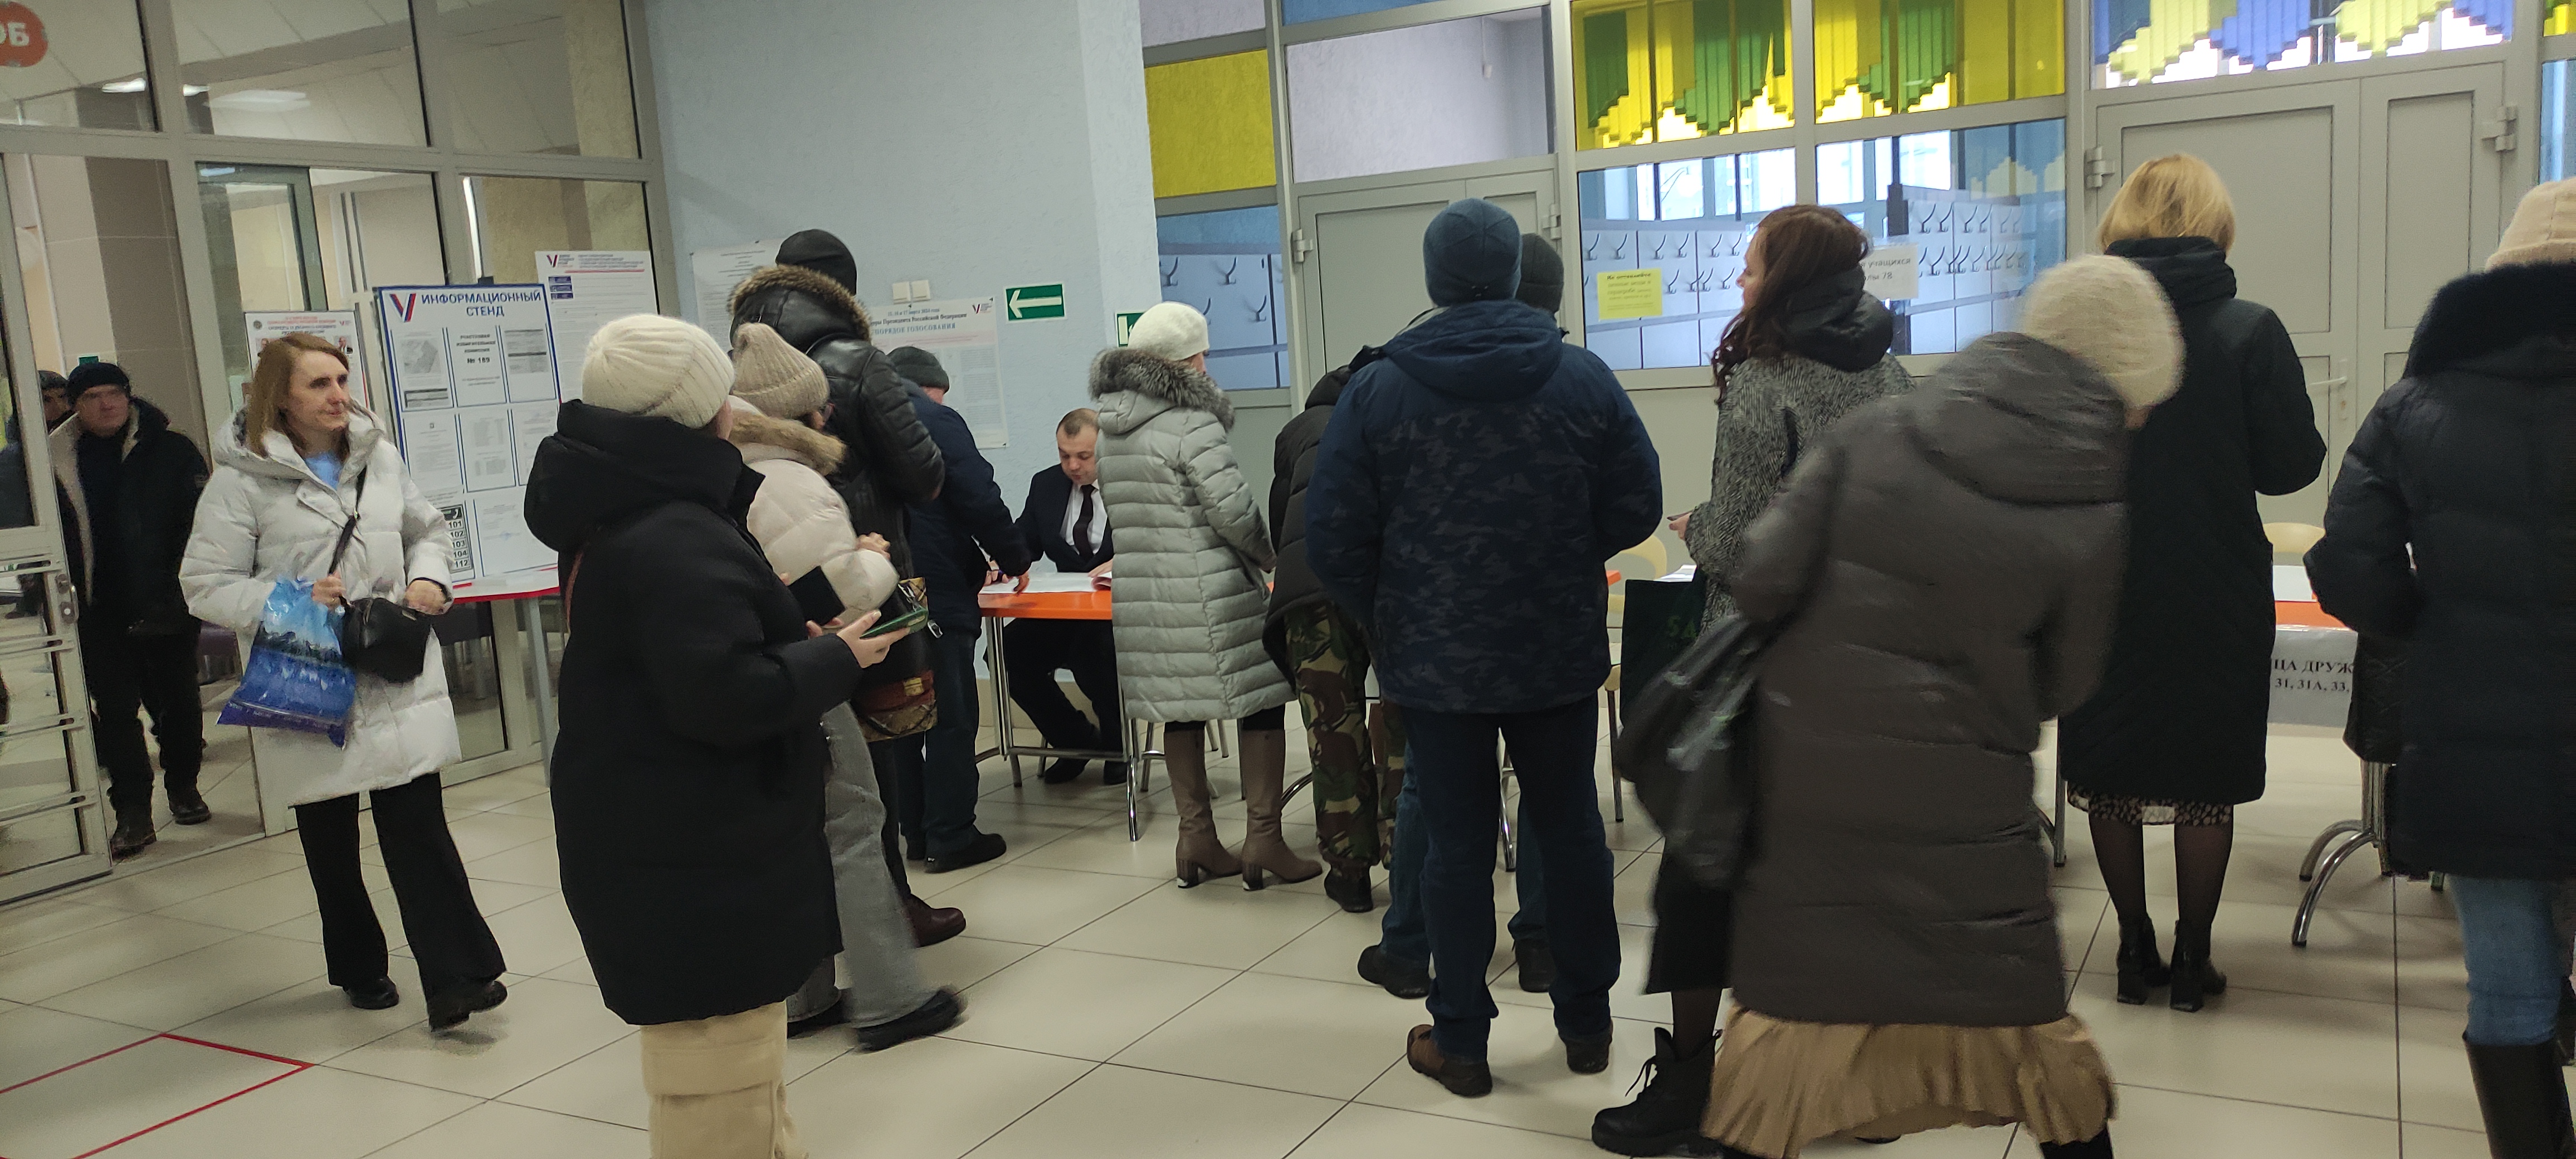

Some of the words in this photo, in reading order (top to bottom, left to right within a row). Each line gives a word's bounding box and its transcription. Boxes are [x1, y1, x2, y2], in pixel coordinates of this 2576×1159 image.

[422, 290, 541, 304] ИНФОРМАЦИОННЫЙ
[466, 305, 505, 317] СТЕНД
[448, 520, 462, 529] 101
[455, 559, 468, 568] 112
